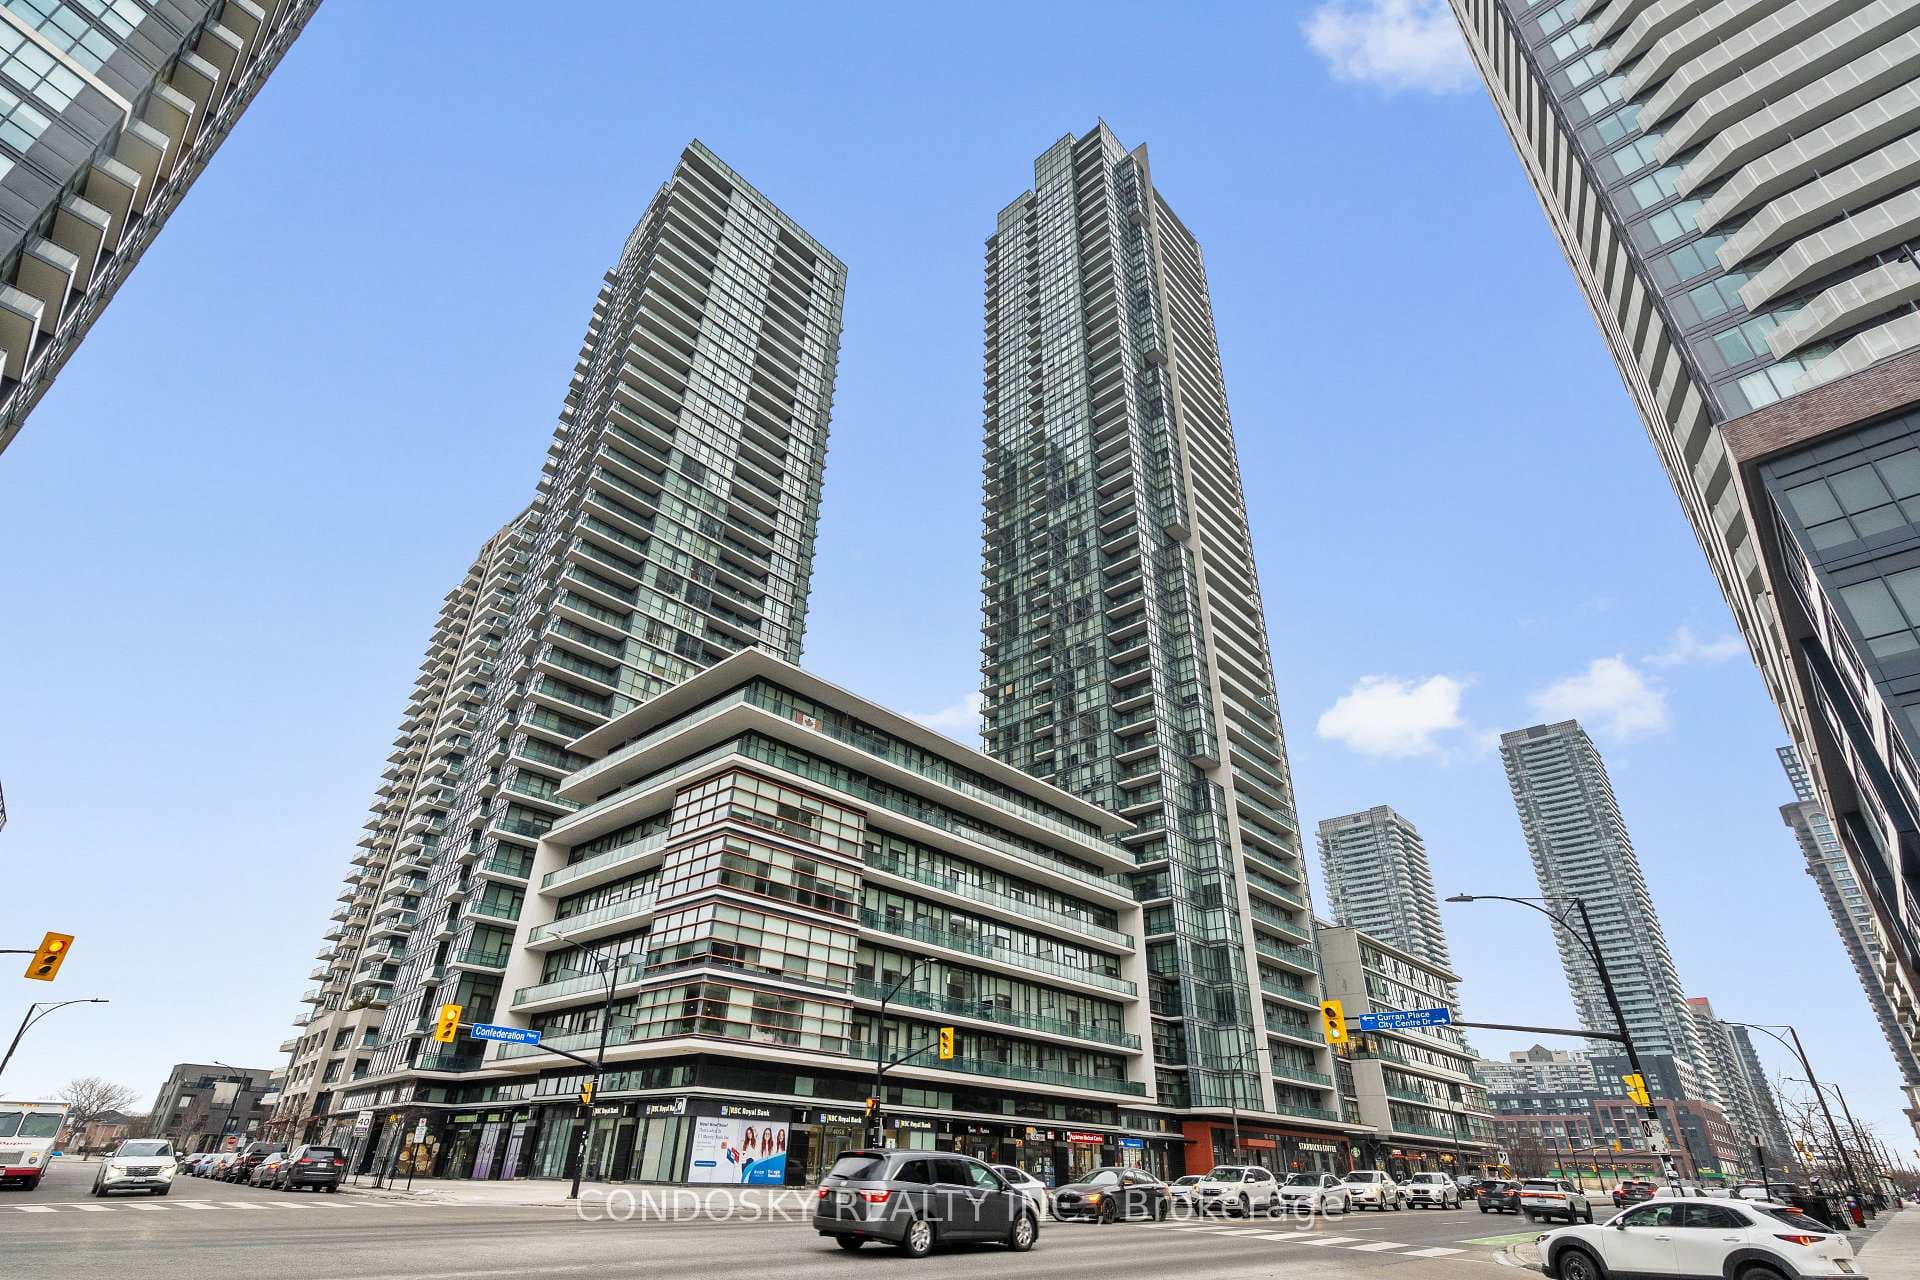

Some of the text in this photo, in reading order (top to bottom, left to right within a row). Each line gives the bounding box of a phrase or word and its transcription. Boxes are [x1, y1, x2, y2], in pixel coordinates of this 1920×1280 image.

[1377, 1011, 1430, 1021] Curran Place
[1378, 1020, 1393, 1029] City
[1395, 1019, 1420, 1027] Centre
[475, 1026, 525, 1041] Confederation
[742, 1107, 757, 1117] Royal
[757, 1108, 770, 1117] Bank
[838, 1114, 850, 1124] Royal
[851, 1115, 862, 1123] Bank
[910, 1121, 921, 1129] Royal
[922, 1121, 931, 1129] Bank
[1298, 1142, 1337, 1153] STARBUCKS COFFEE
